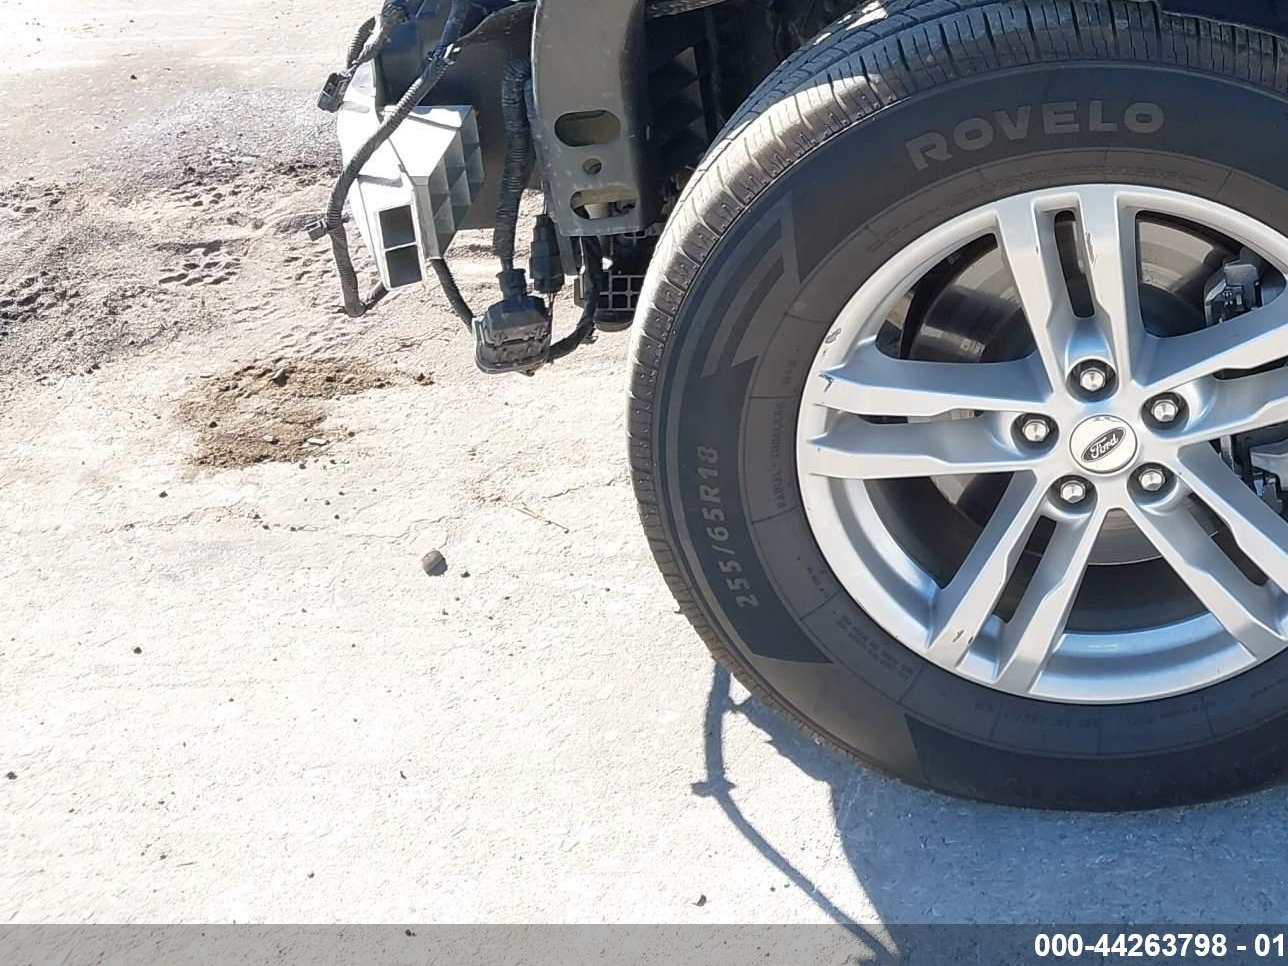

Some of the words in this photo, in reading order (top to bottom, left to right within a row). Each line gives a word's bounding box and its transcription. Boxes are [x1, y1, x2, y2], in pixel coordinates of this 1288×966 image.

[905, 100, 1166, 171] ROVELO
[1090, 433, 1119, 459] Ford
[696, 445, 760, 609] 255/65R18
